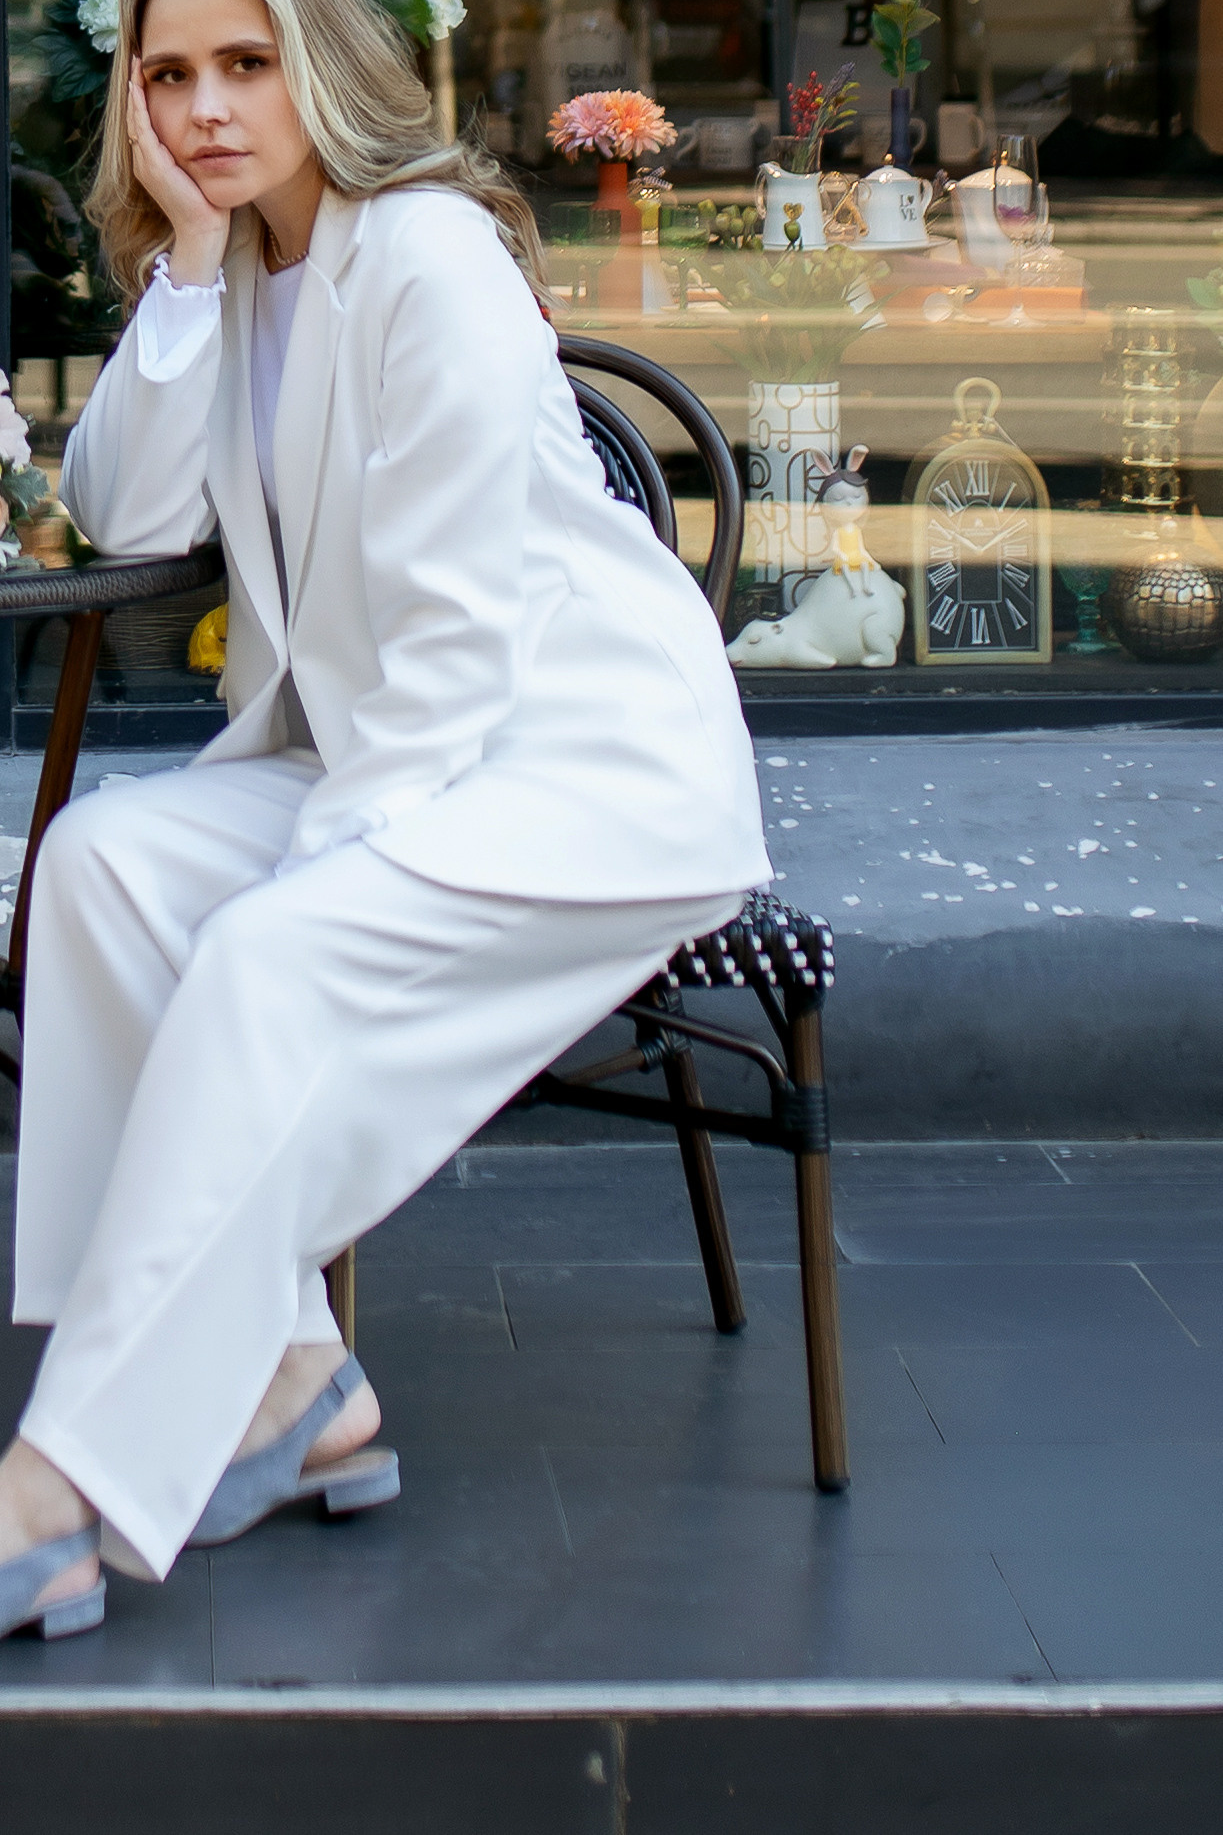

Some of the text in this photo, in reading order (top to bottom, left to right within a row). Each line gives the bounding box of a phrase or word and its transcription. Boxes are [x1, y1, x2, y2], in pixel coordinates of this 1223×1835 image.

[842, 4, 874, 46] B
[965, 460, 990, 496] XII
[934, 480, 965, 517] XI
[998, 481, 1017, 512] I
[928, 561, 956, 592] VIII
[930, 594, 960, 635] VII
[970, 607, 991, 645] VI
[1005, 597, 1029, 631] V
